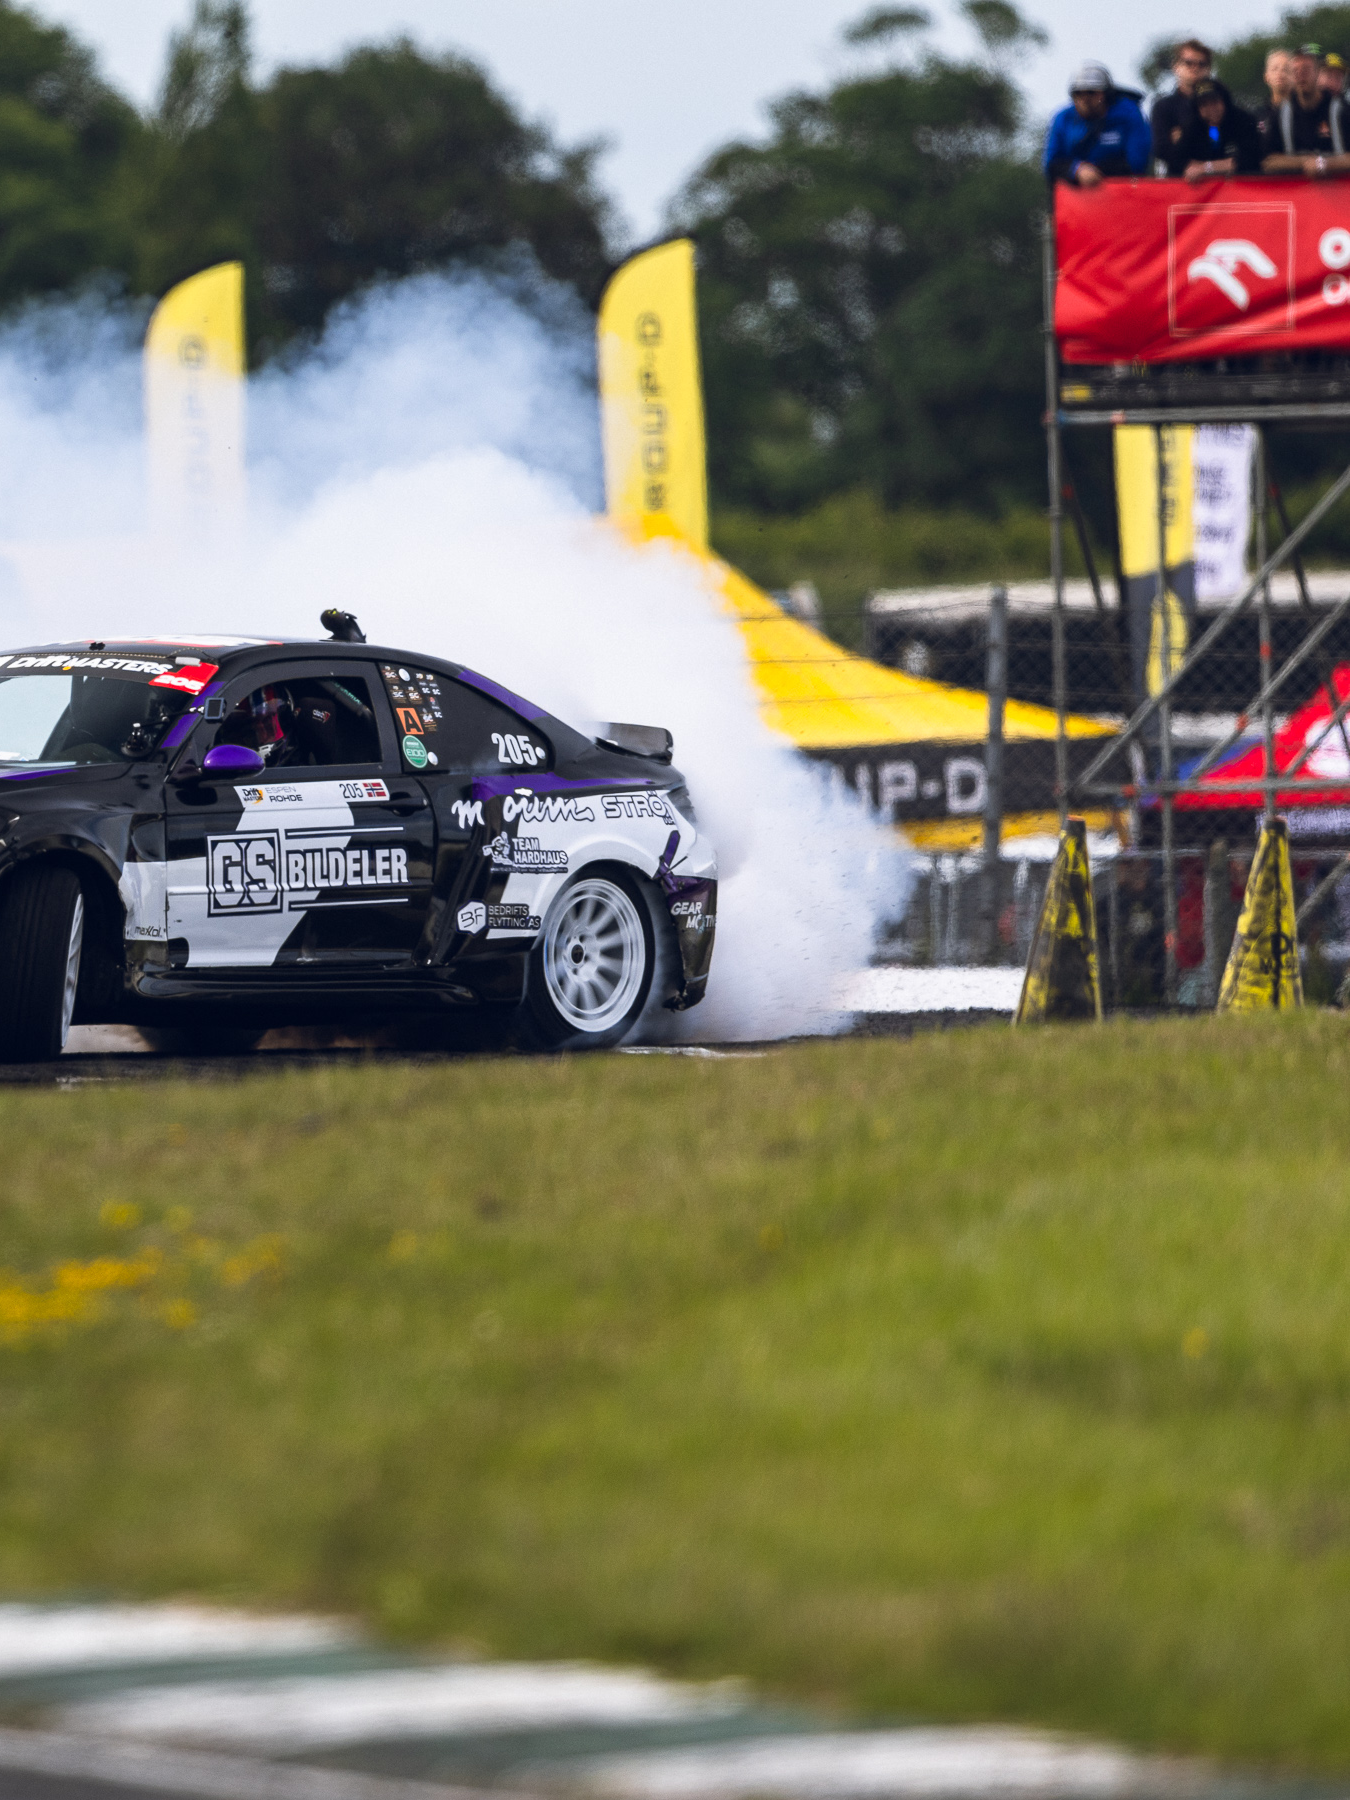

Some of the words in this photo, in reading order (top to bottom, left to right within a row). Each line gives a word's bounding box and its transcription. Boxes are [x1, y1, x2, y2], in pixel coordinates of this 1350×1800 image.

[67, 657, 173, 675] MASTERS
[154, 674, 205, 691] 205
[403, 710, 422, 732] A
[491, 733, 538, 766] 205
[265, 786, 297, 794] ESPEN
[269, 794, 303, 803] ROHDE
[339, 782, 363, 799] 205
[512, 838, 539, 850] TEAM
[513, 851, 568, 864] HARDHAUS
[213, 839, 277, 907] GS
[287, 847, 410, 891] BILDELER
[488, 905, 528, 916] BEDRIFTS
[671, 901, 702, 915] GEAR
[461, 906, 484, 928] BF
[488, 917, 525, 927] FLYTTING
[527, 918, 540, 928] AS
